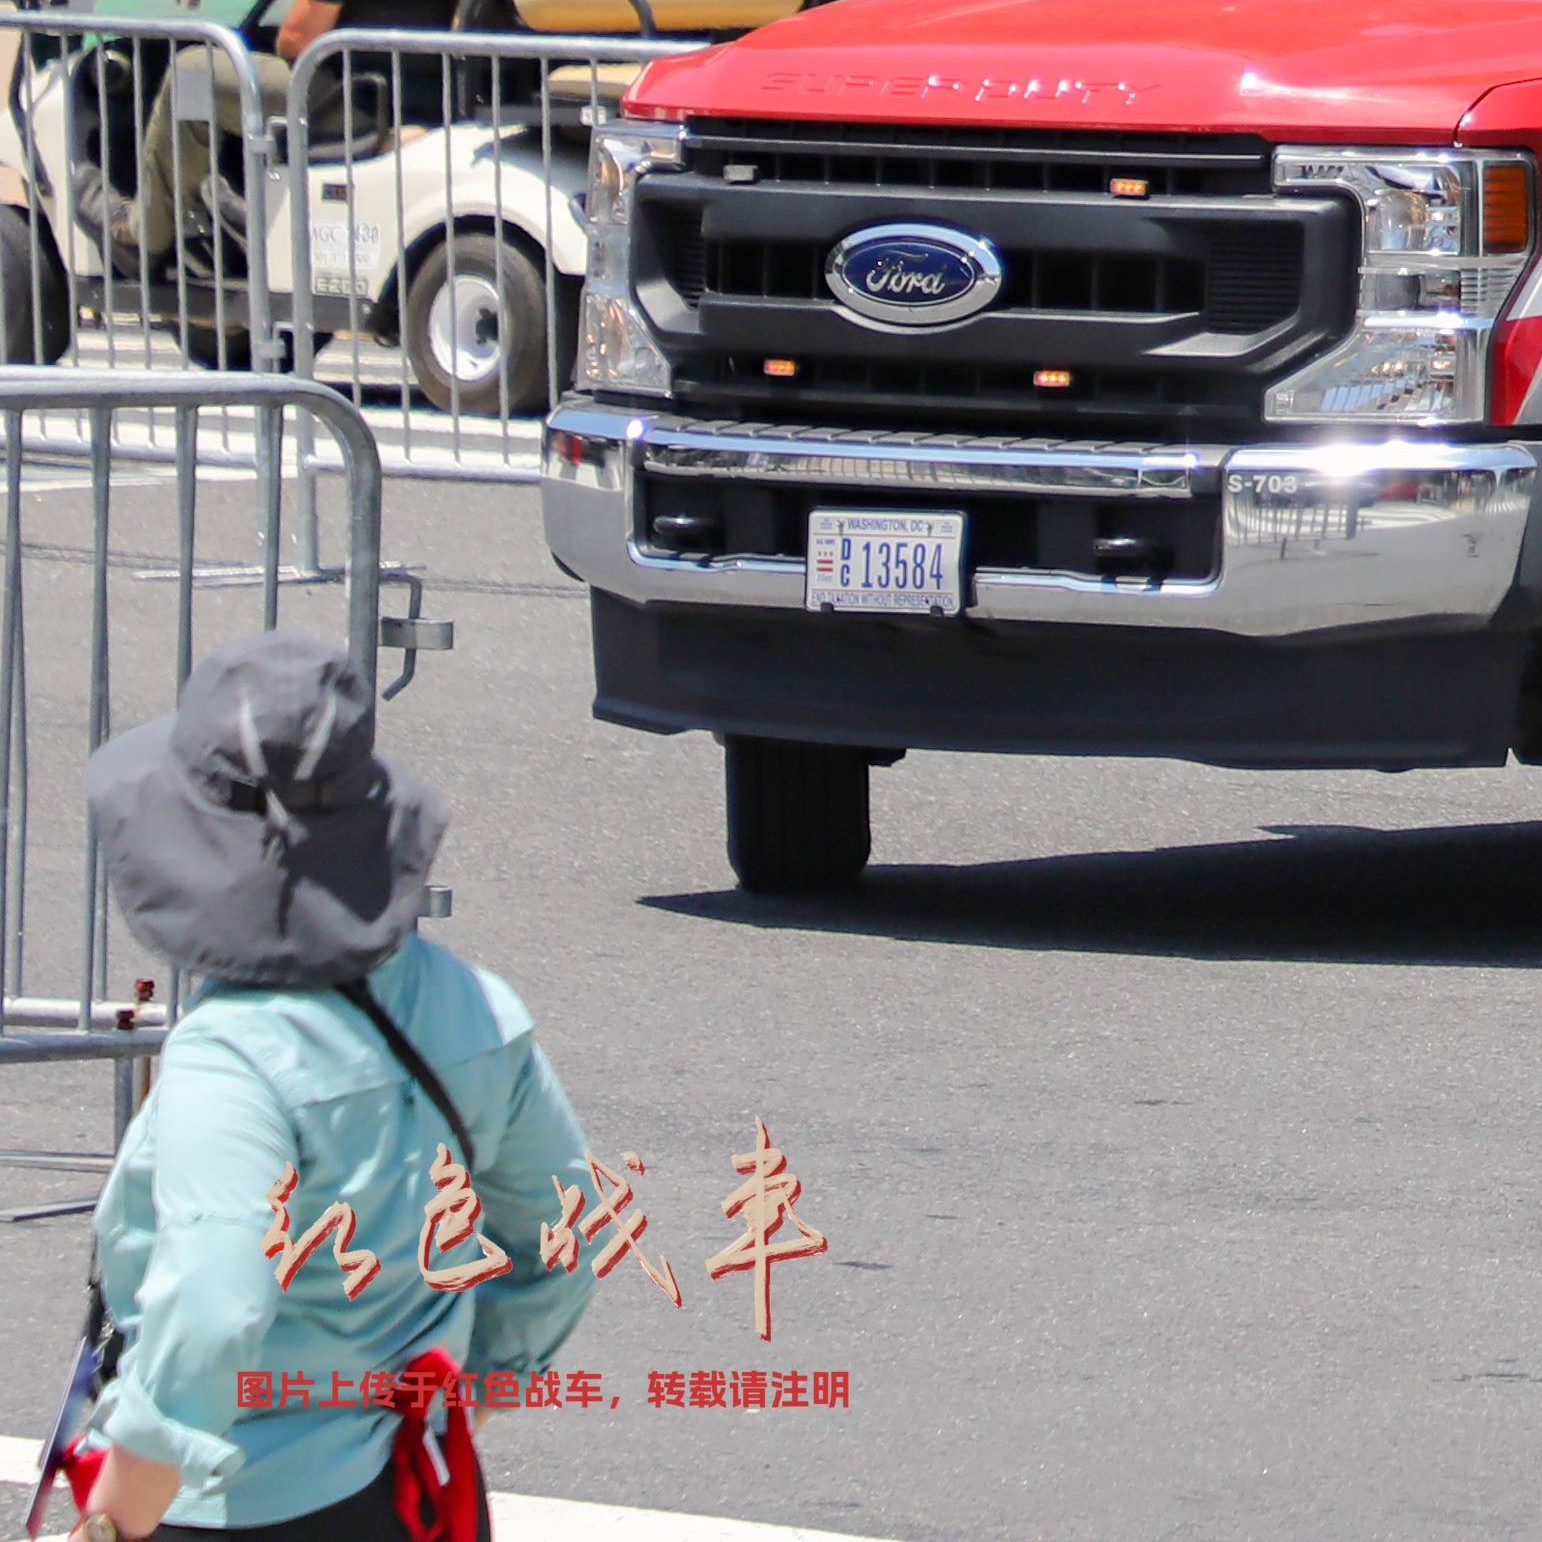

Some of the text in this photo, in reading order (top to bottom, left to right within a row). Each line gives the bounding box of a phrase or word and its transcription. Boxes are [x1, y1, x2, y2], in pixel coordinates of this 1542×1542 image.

[866, 253, 948, 296] Ford
[1227, 474, 1298, 494] S-703
[848, 519, 923, 533] WASHINGTON, DC
[861, 541, 943, 590] 13584
